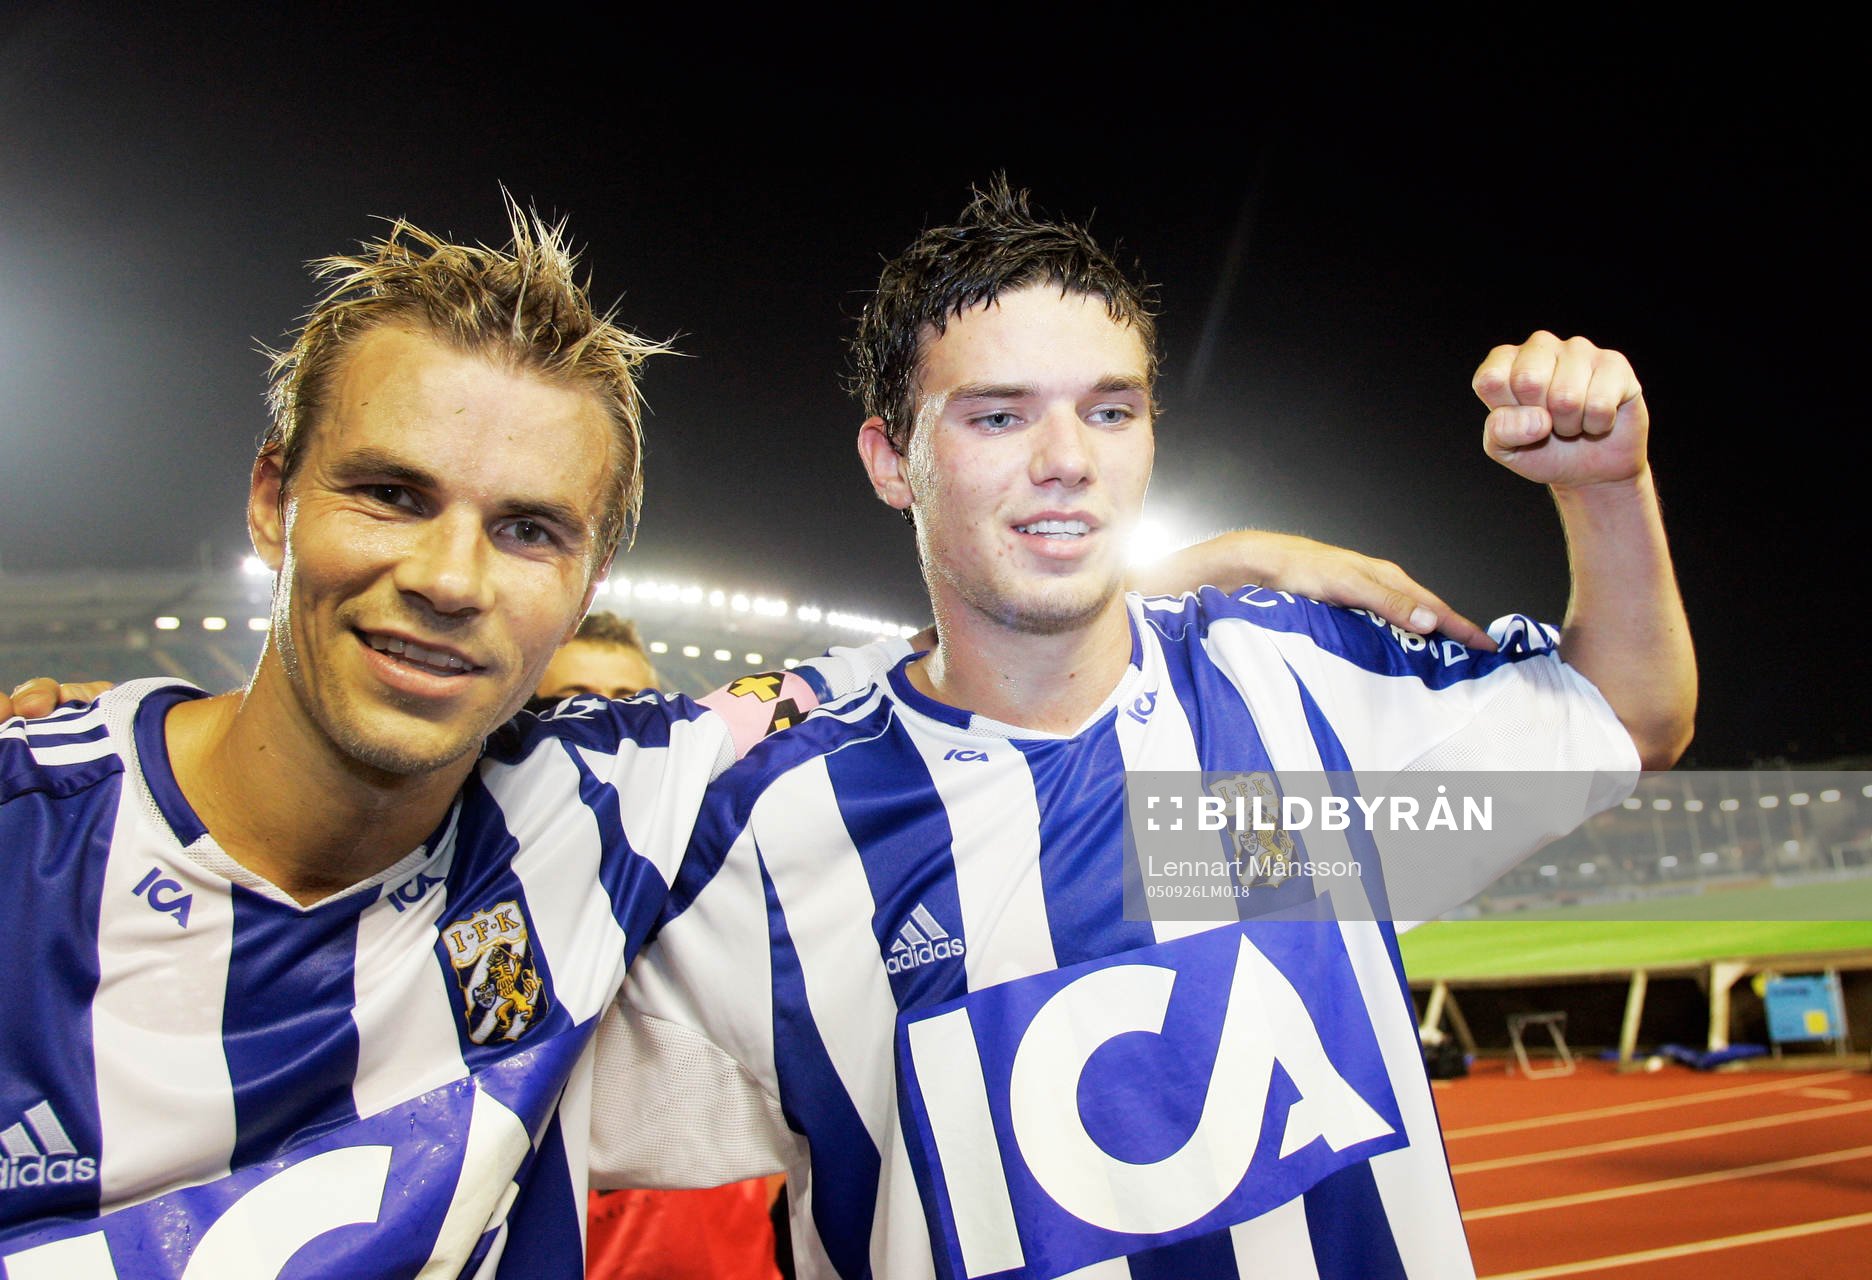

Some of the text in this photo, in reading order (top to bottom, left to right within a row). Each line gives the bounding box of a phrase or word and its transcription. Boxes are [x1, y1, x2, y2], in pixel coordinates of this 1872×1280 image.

[943, 749, 989, 762] ICA
[131, 866, 193, 929] ICA
[386, 872, 447, 913] ICA
[886, 938, 965, 975] adidas
[906, 932, 1397, 1280] ICA
